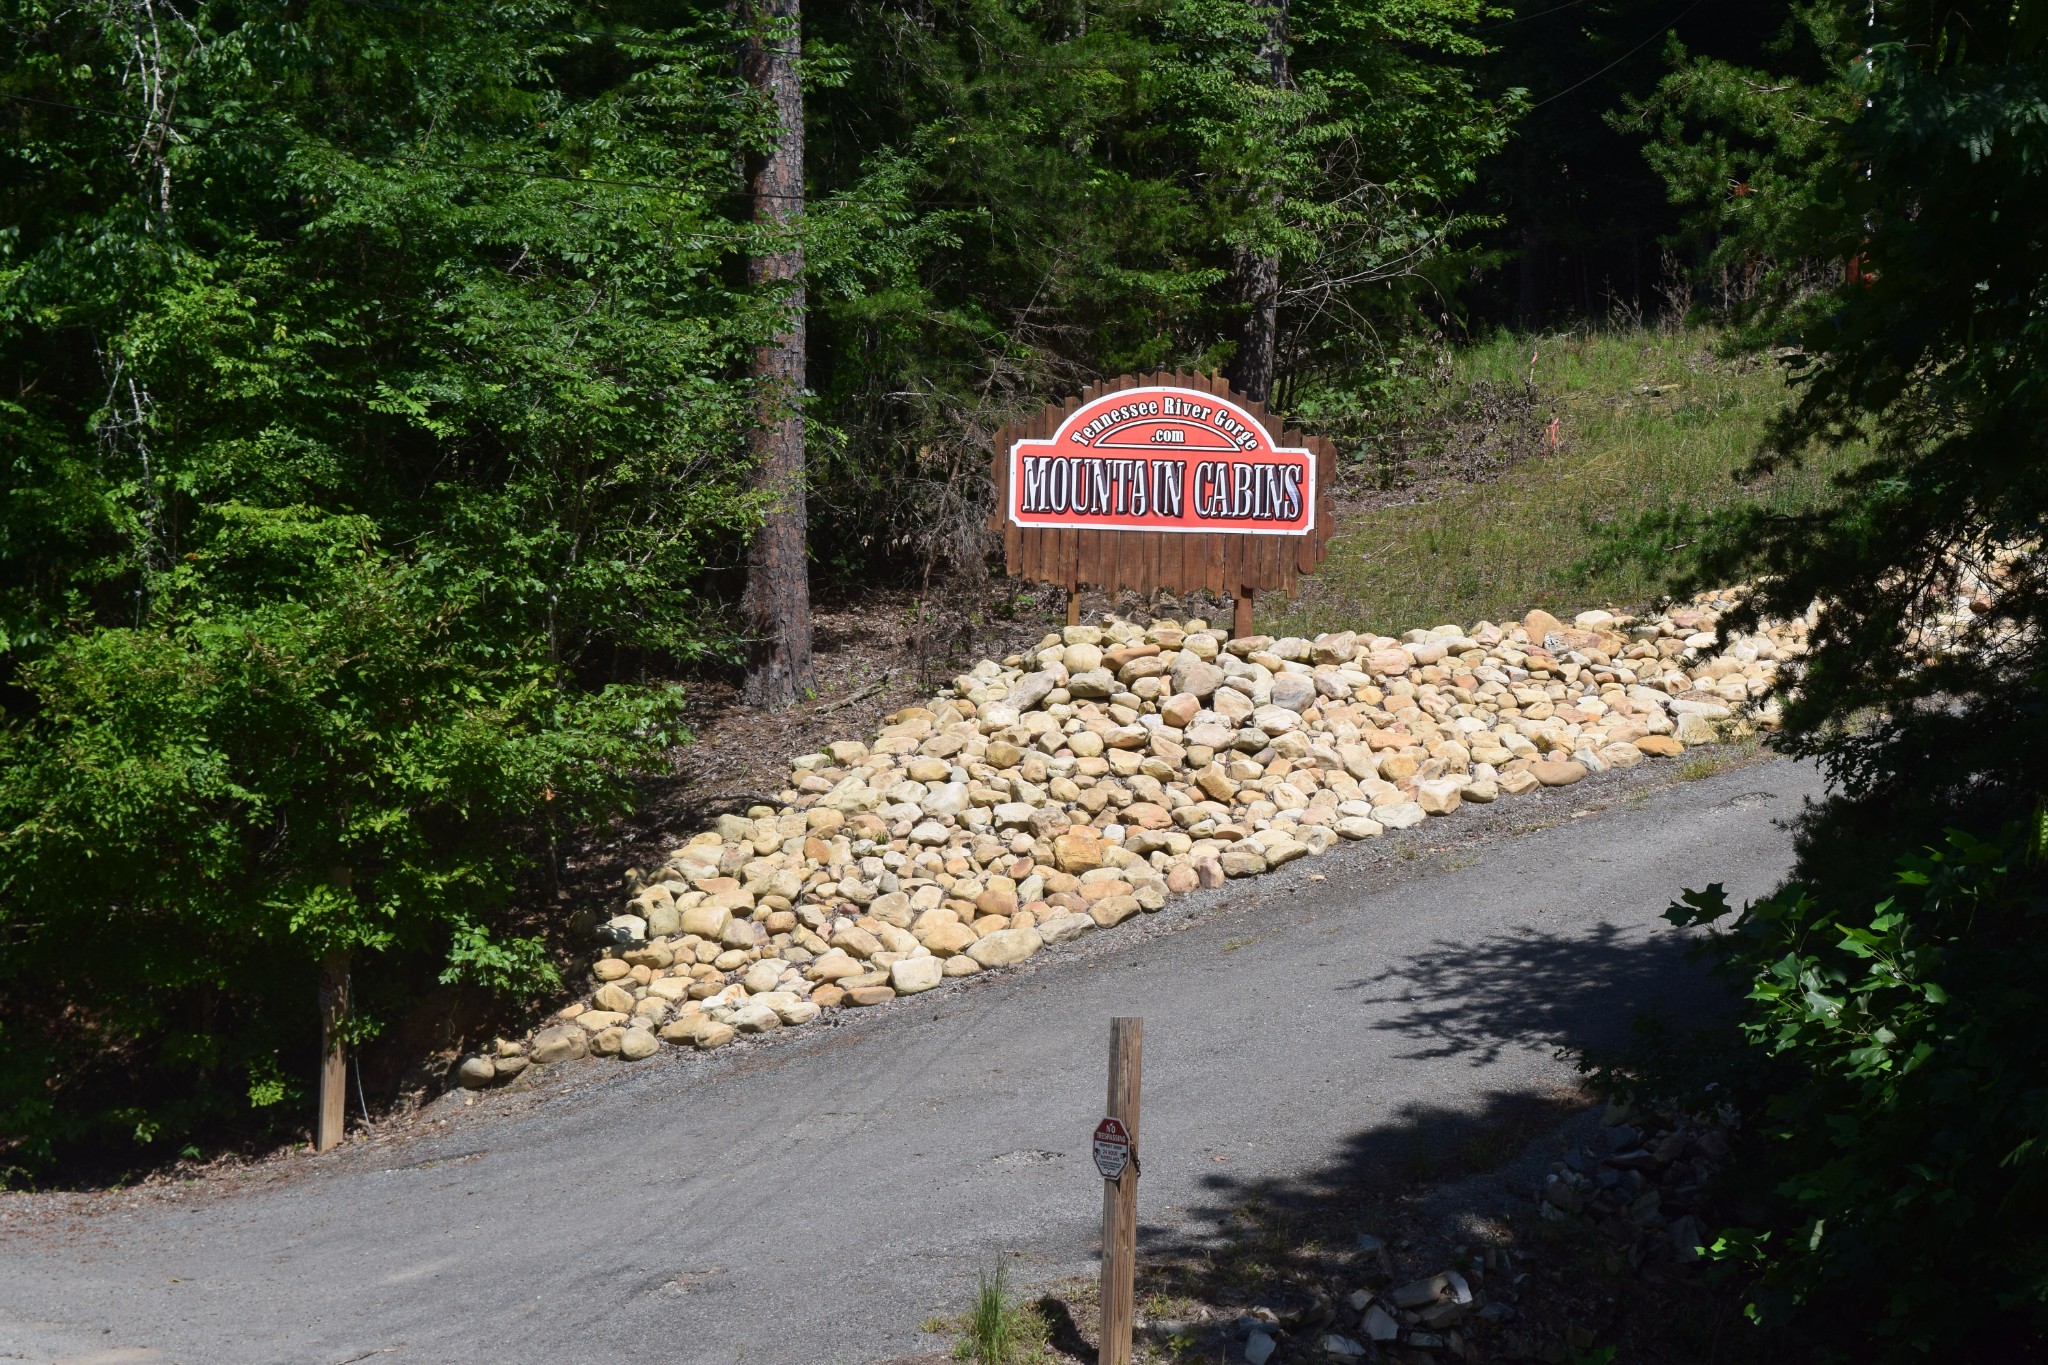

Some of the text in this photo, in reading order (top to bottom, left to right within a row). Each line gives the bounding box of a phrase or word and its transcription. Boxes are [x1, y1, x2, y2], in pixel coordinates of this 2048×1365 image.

[1071, 397, 1258, 451] Tennessee River Gorge
[1150, 428, 1185, 443] .com
[1021, 456, 1303, 520] MOUNTAIN CABINS
[1106, 1125, 1116, 1133] NO
[1096, 1132, 1126, 1143] TRESPASSING
